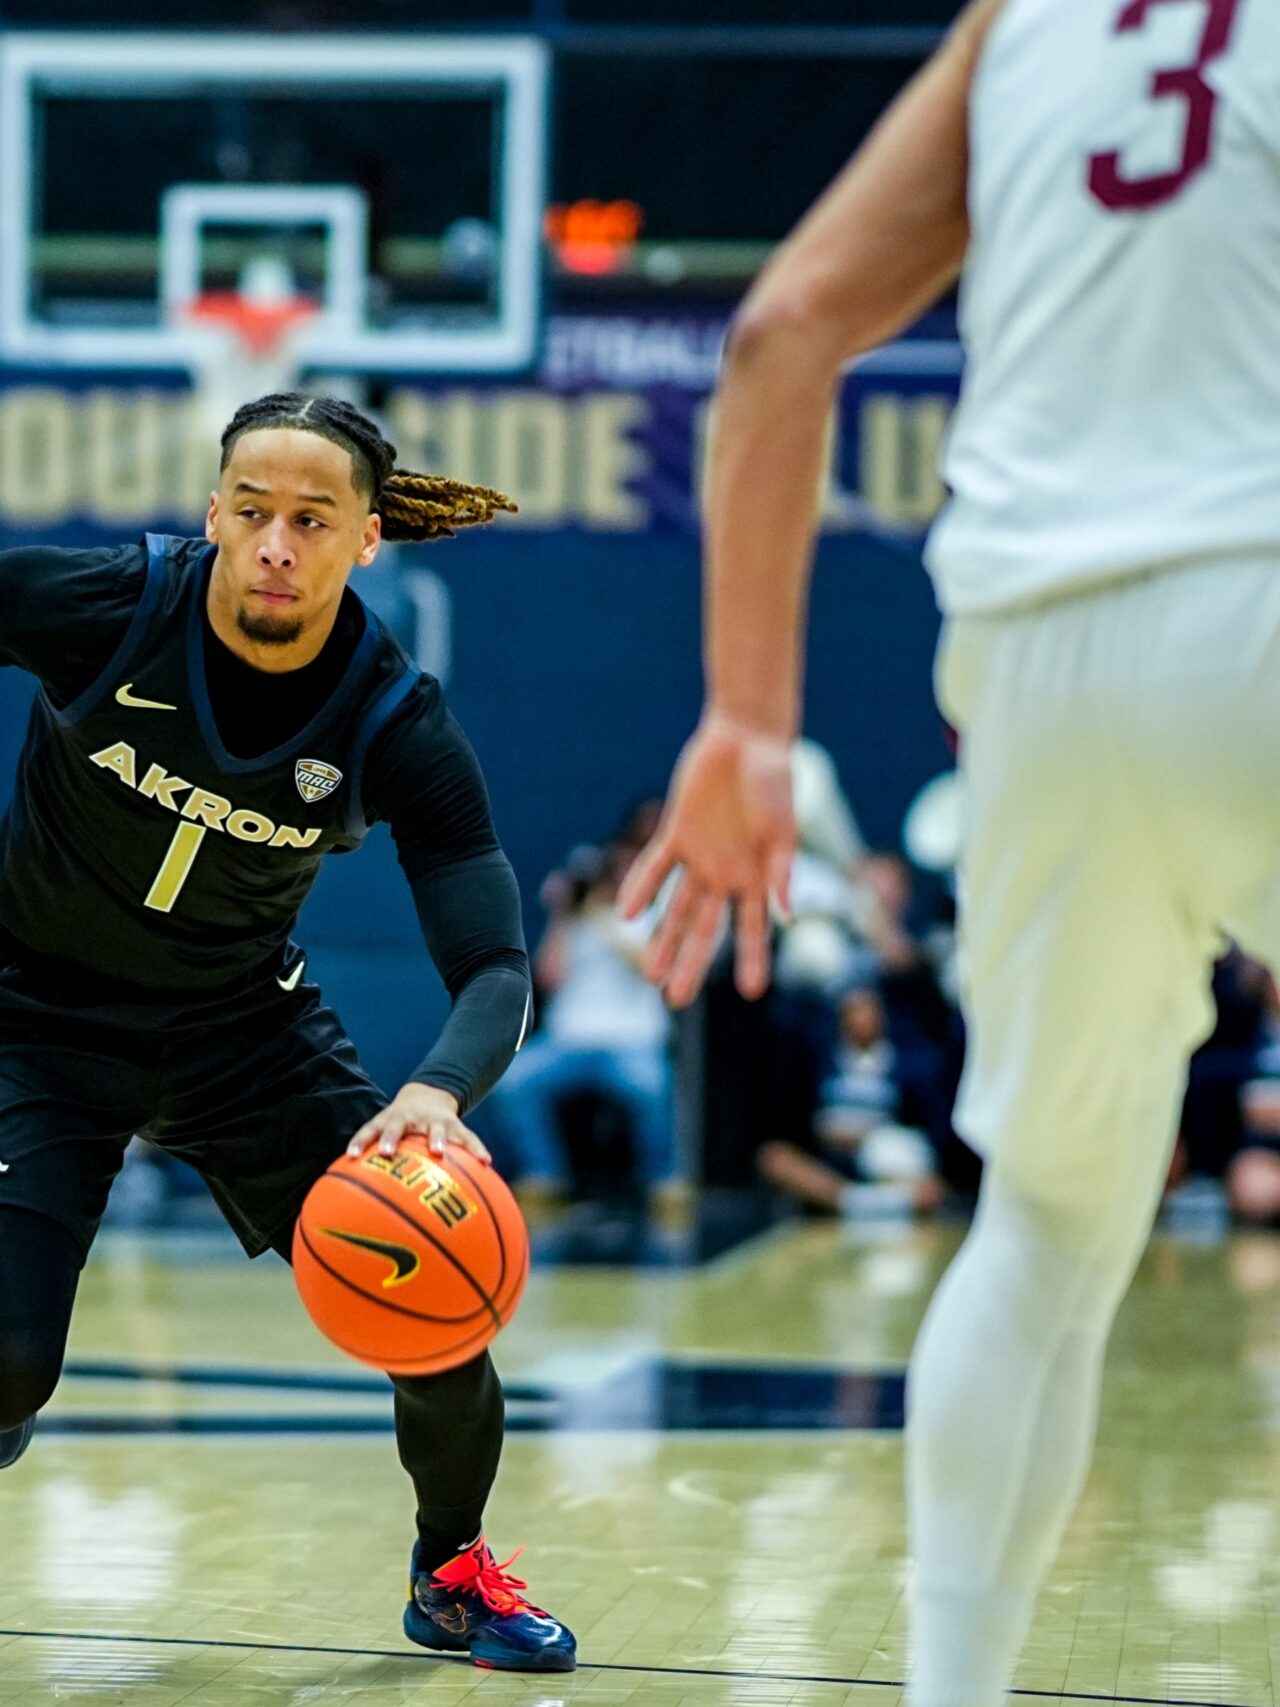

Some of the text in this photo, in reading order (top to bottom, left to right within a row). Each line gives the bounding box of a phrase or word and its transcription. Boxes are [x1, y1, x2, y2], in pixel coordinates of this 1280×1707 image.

[1087, 0, 1237, 212] 3
[89, 741, 322, 848] AKRON
[297, 769, 336, 790] MAC
[144, 820, 207, 913] 1
